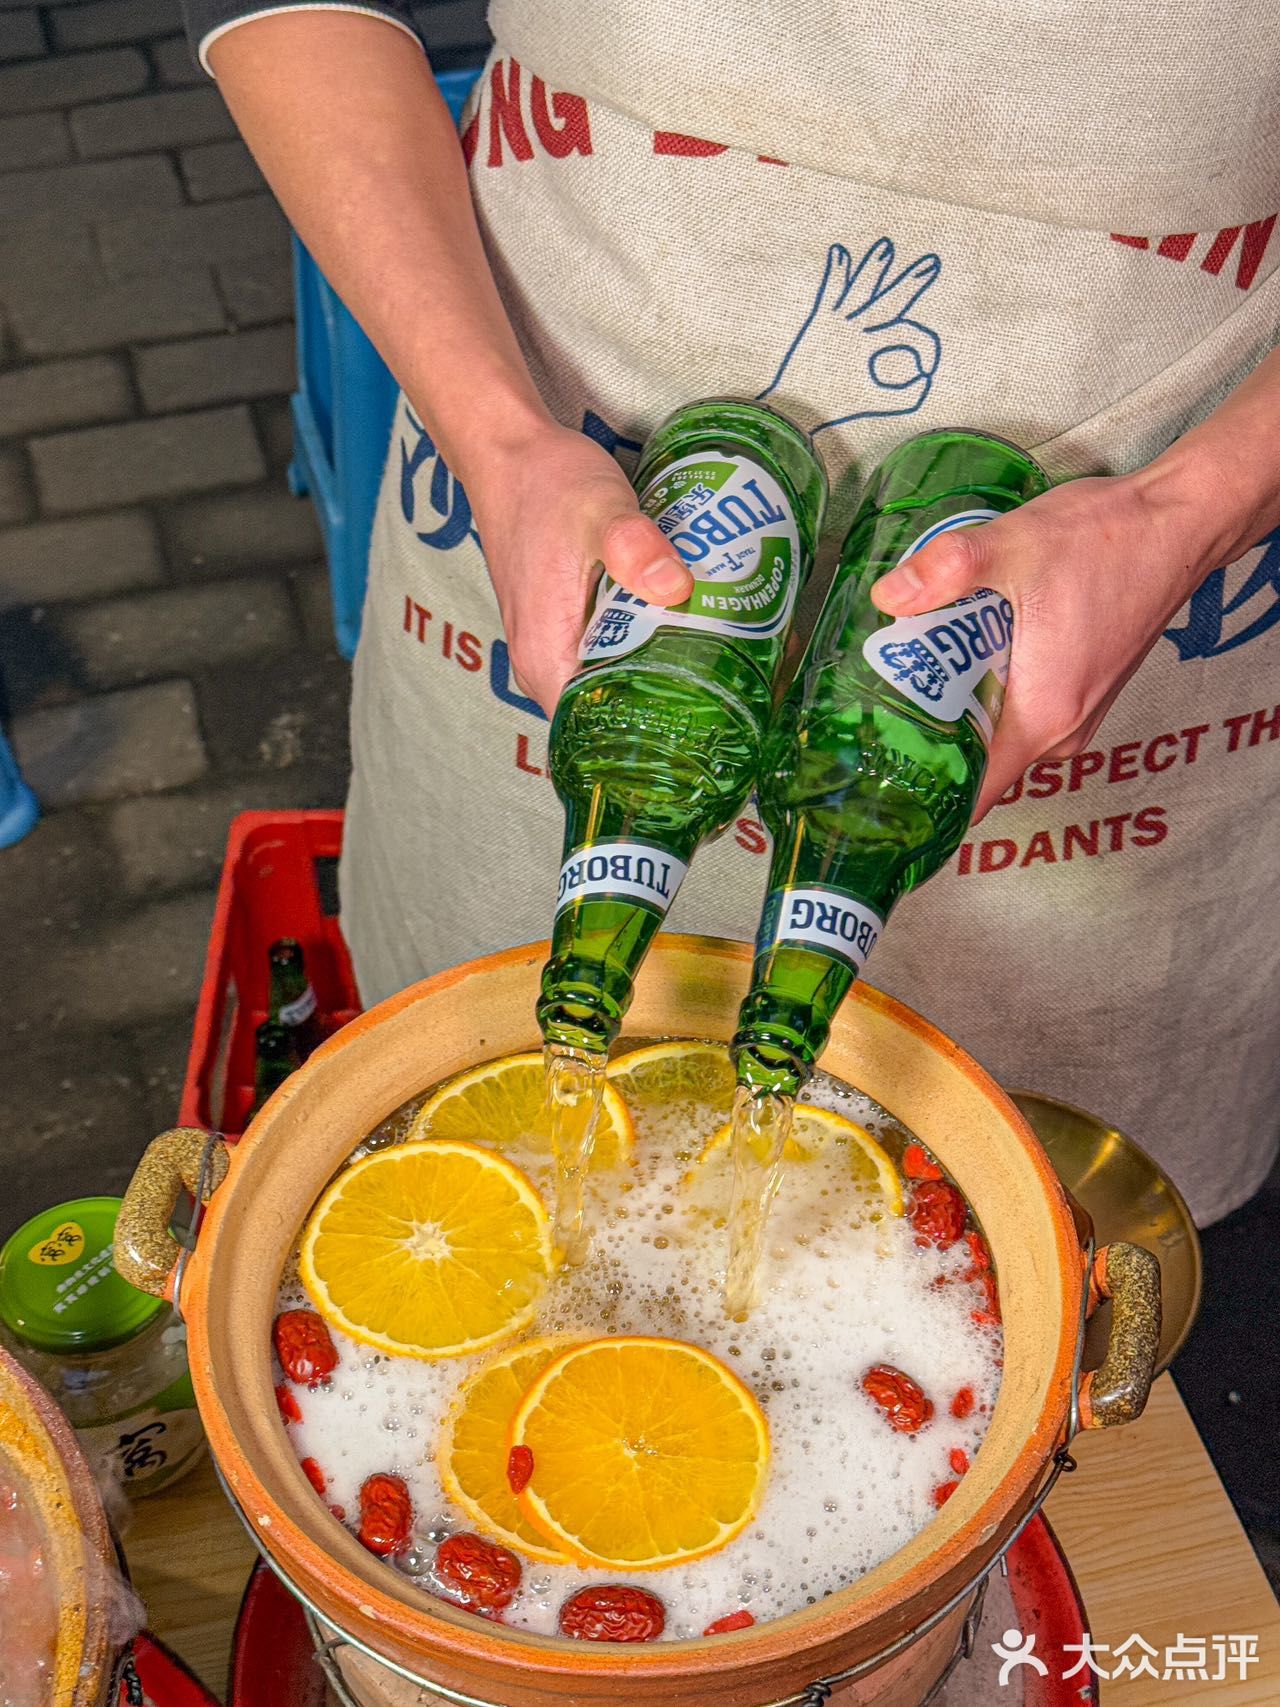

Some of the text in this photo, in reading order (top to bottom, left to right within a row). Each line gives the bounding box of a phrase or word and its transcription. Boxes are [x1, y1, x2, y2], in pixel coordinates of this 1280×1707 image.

[669, 478, 787, 568] TUBO
[705, 562, 724, 577] MARK
[736, 547, 756, 560] TRADE
[702, 556, 785, 611] COPENHAGEN
[733, 574, 765, 593] DENMARK
[403, 596, 483, 672] IT IS
[957, 806, 1169, 876] IDANTS
[789, 897, 877, 961] UBORG
